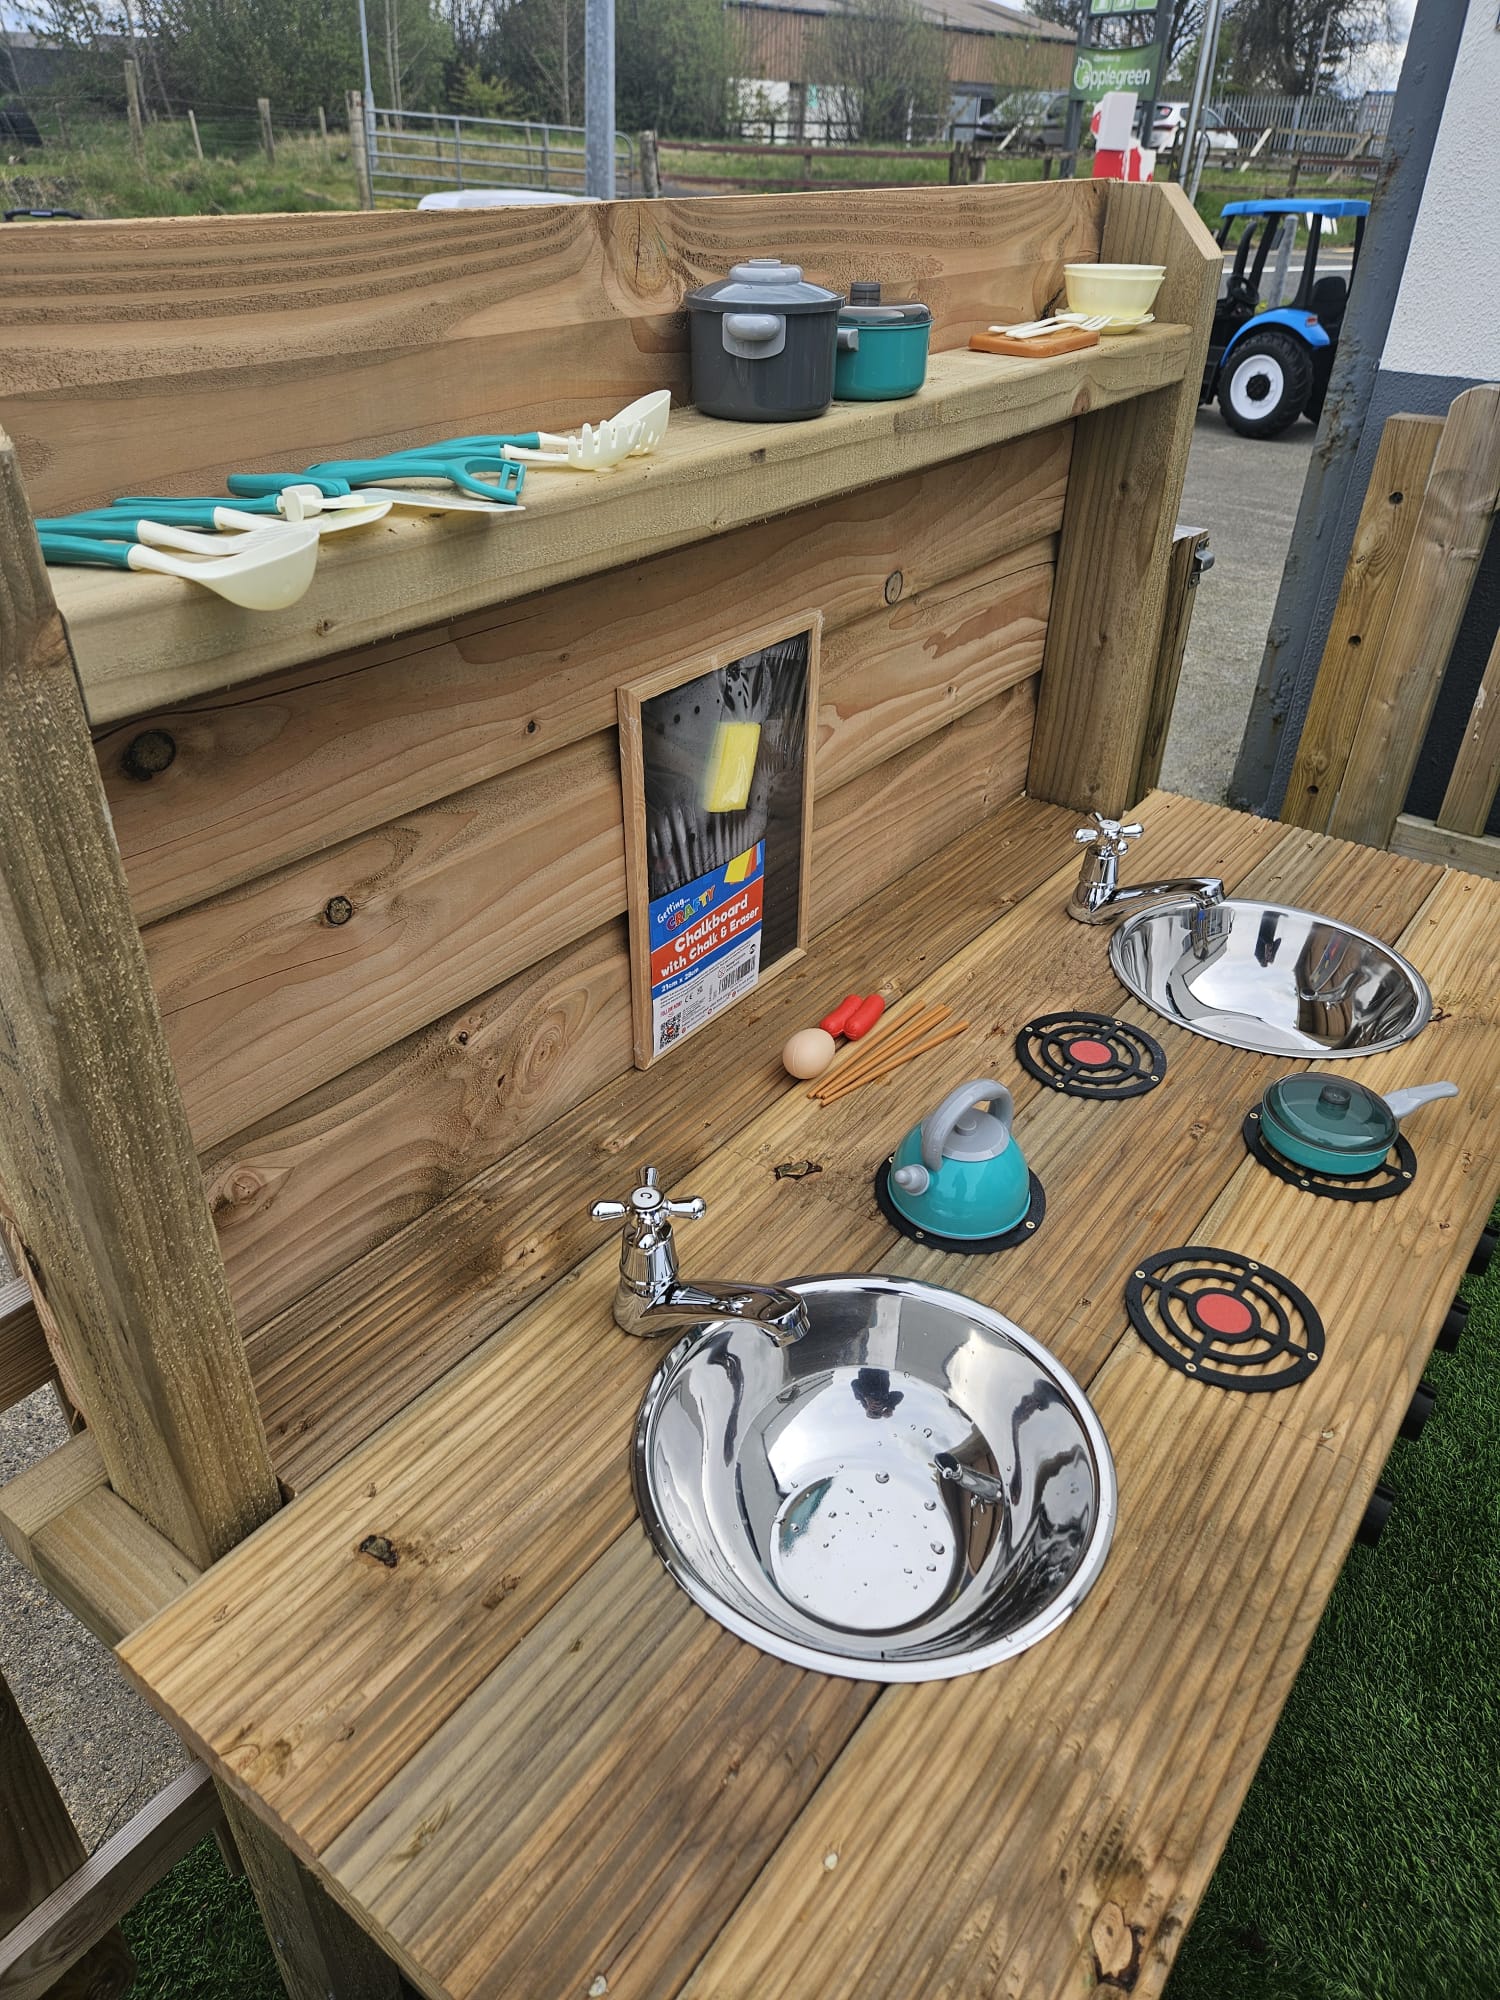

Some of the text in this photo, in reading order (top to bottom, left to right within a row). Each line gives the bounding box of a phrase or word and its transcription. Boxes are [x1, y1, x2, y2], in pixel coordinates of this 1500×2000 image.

[1077, 63, 1150, 90] applegreen
[666, 884, 716, 931] CRAFTY
[674, 893, 749, 953] Chalkboard
[660, 906, 760, 976] with Chalk & Eraser
[661, 981, 678, 992] 21cm
